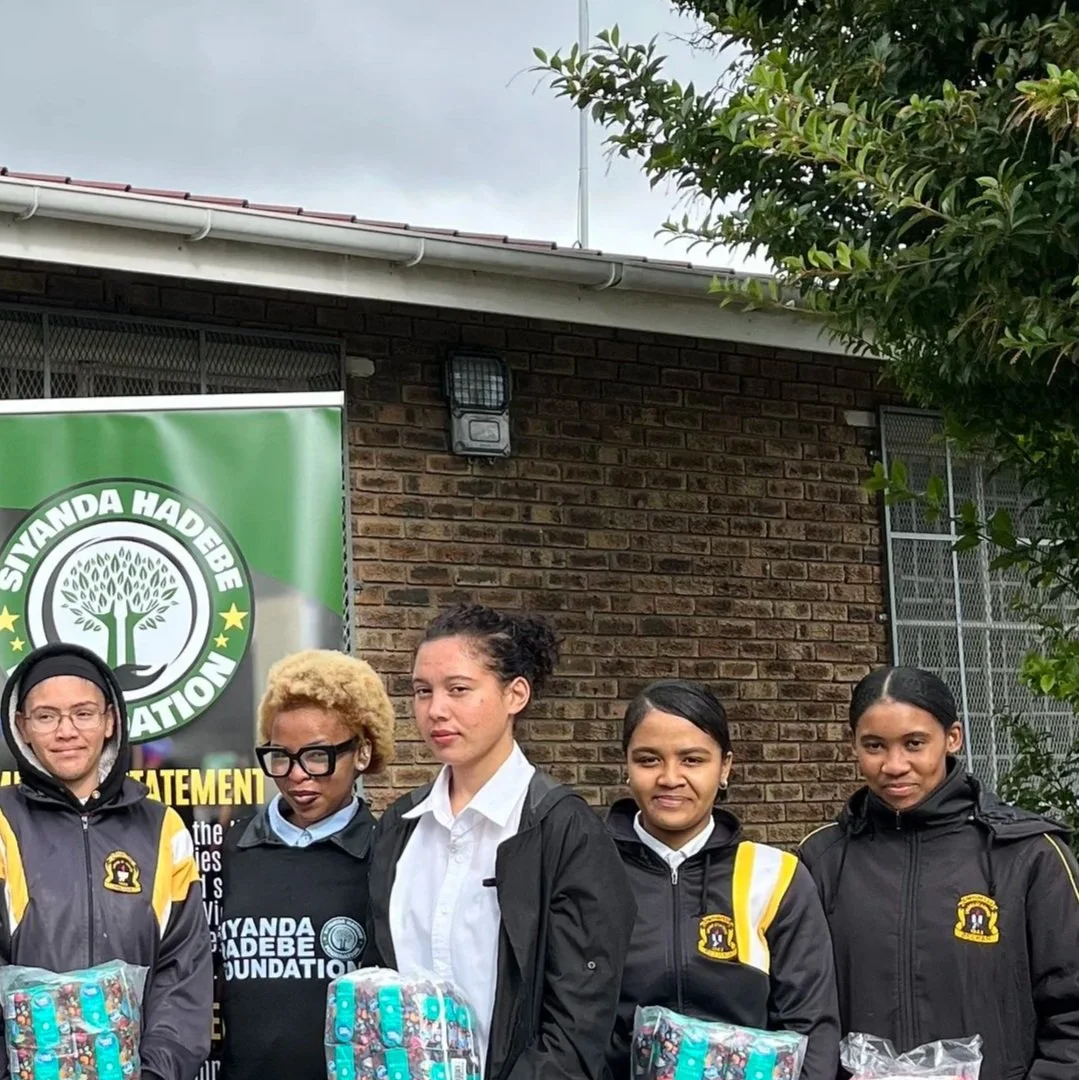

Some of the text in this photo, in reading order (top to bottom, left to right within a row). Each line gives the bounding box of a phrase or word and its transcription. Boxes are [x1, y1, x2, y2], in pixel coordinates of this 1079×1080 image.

[132, 489, 243, 592] HADEBE
[127, 651, 237, 738] ATION
[192, 820, 223, 846] the
[222, 936, 315, 959] ADEBE
